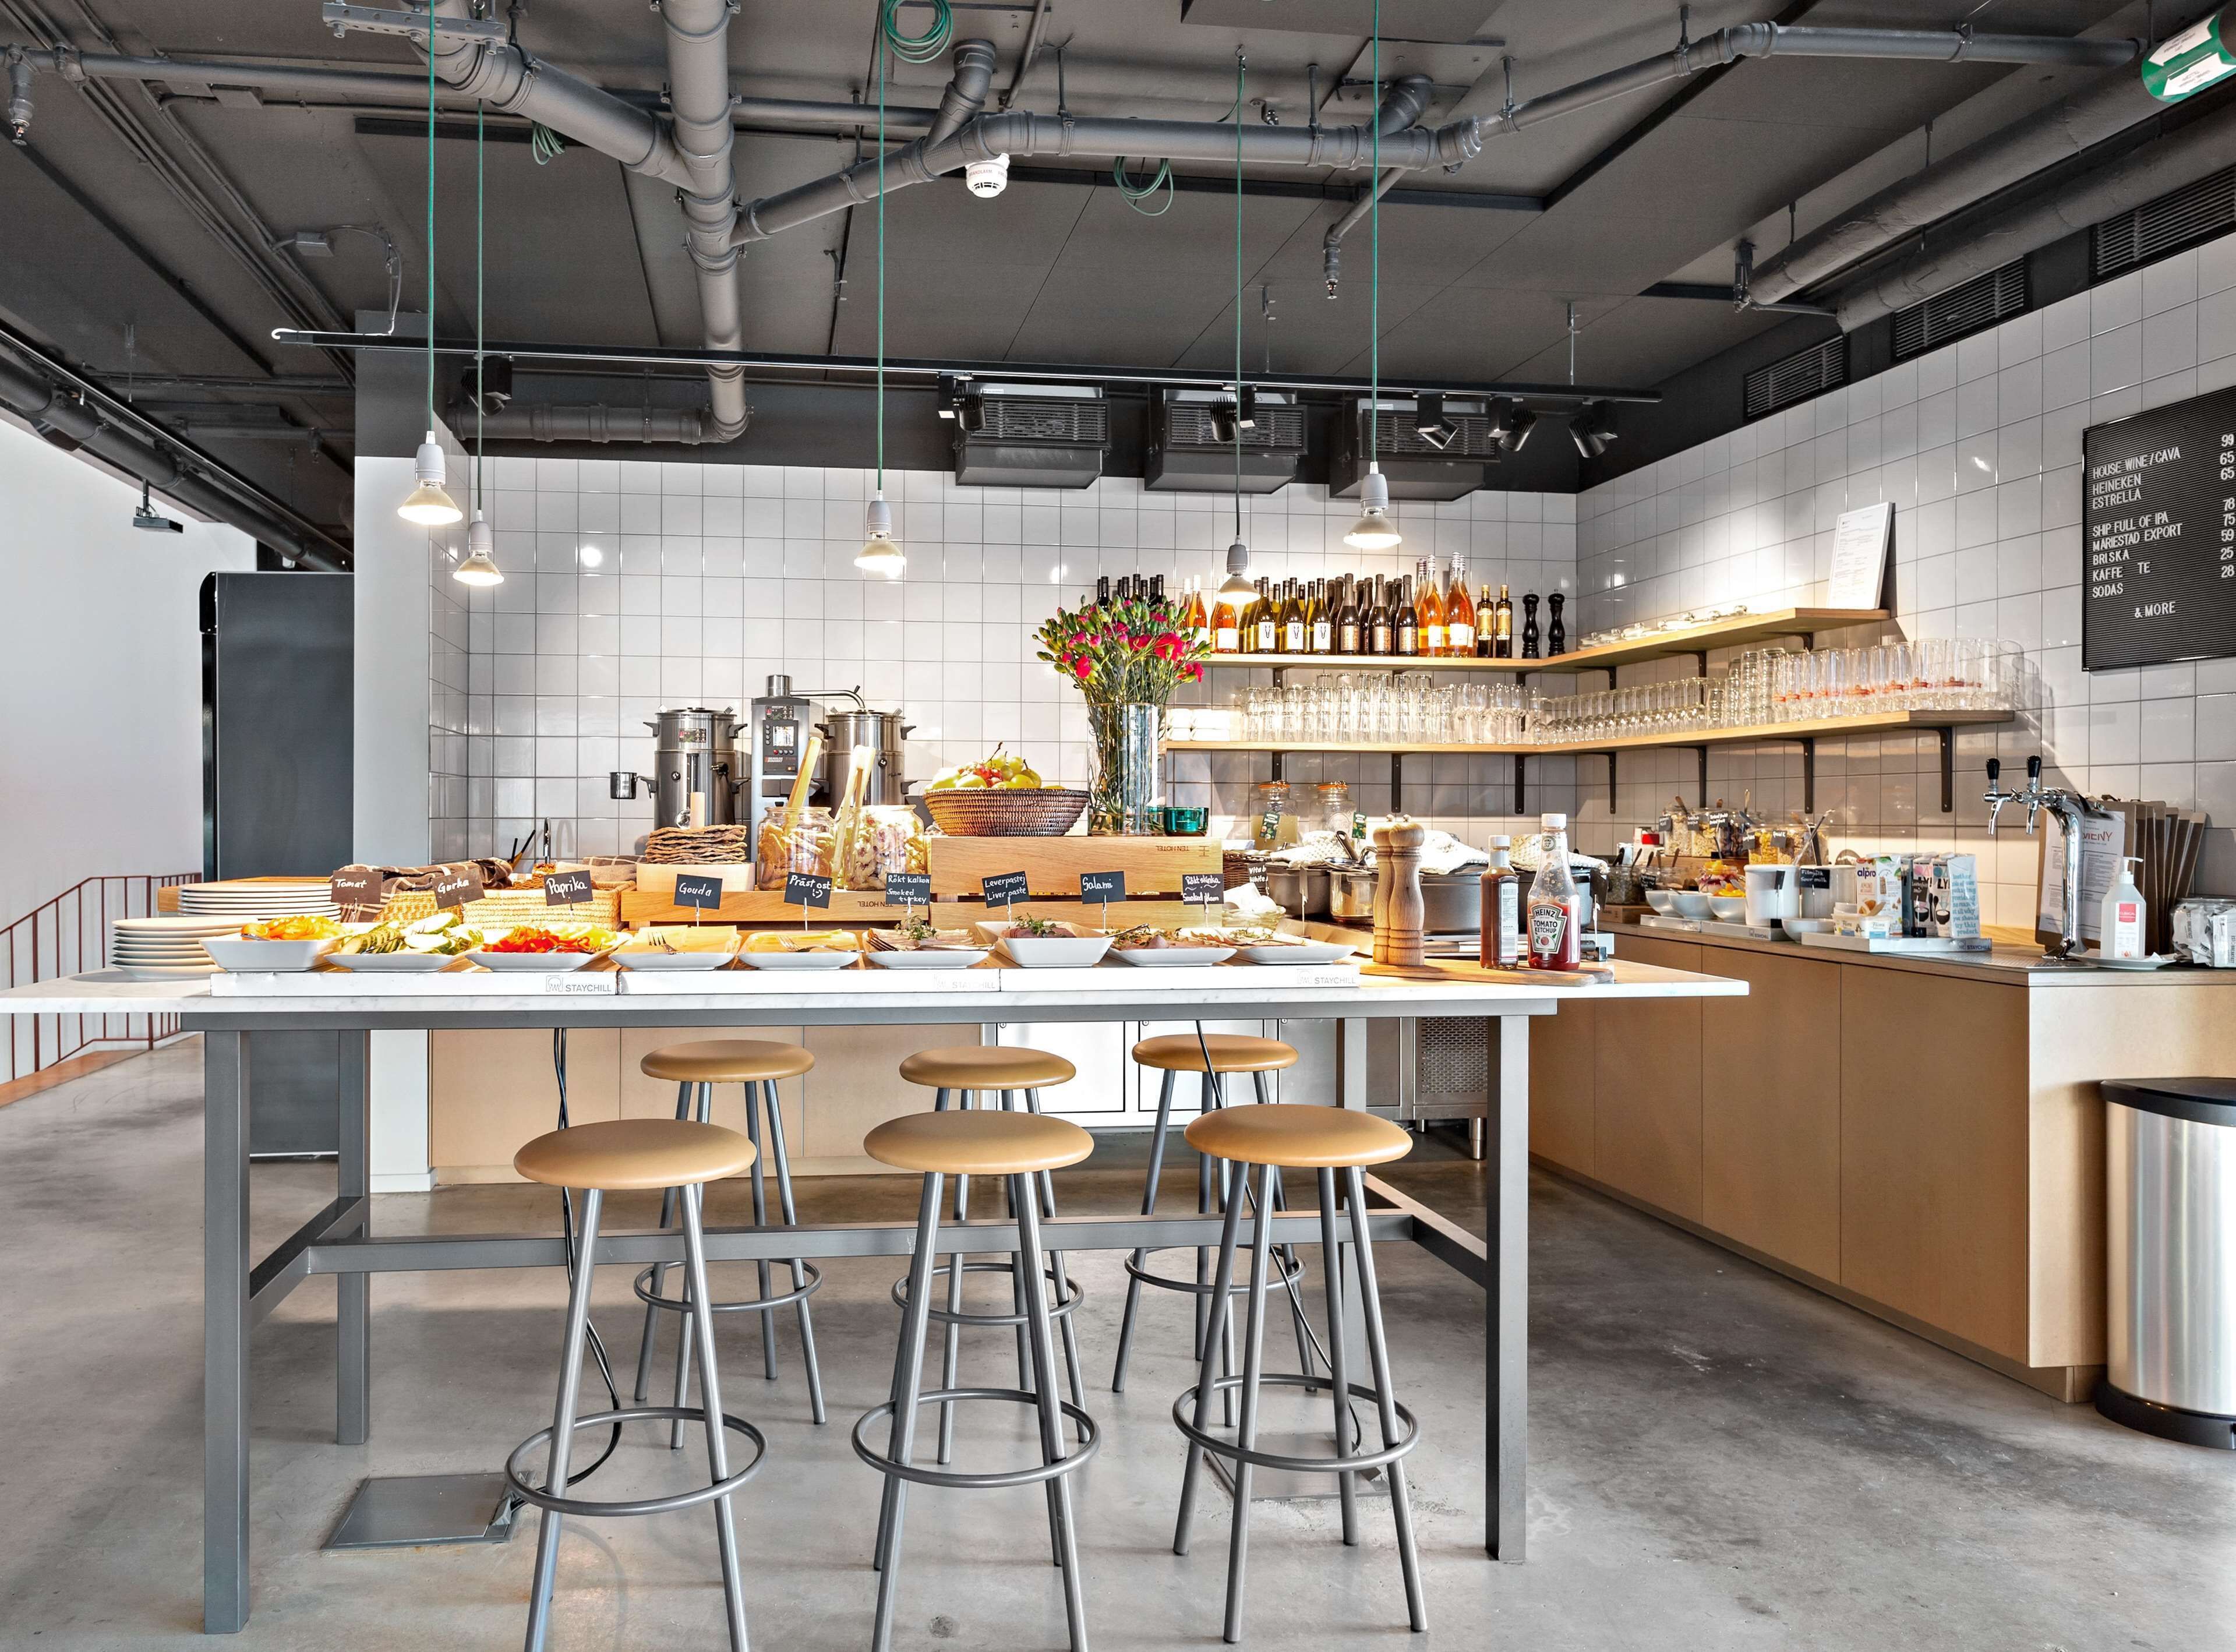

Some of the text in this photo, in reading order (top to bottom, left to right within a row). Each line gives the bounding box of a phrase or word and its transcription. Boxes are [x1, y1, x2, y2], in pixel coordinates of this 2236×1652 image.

[2093, 462, 2121, 479] HOUSE
[2221, 434, 2234, 447] 99
[2093, 451, 2235, 495] HEINEKEN 65
[2093, 467, 2235, 509] ESTRELLA 65
[2093, 497, 2235, 536] SHIP FULL OF IPA 78
[2093, 513, 2235, 552] MARIESTAD EXPORT 75
[2093, 528, 2234, 565] BRISKA 59
[2093, 546, 2234, 582] KAFFE TE 25
[2093, 565, 2235, 598] SODAS 28
[2135, 601, 2175, 618] & MORE
[888, 874, 930, 884] Rökt kalkon
[1200, 874, 1221, 884] skinka
[1857, 867, 1876, 879] alpro
[335, 878, 367, 888] Tomat
[437, 878, 469, 894] Gurka
[546, 876, 587, 898] Paprika
[985, 874, 1025, 888] Leverpastej
[1082, 877, 1113, 891] Salami
[679, 882, 712, 897] Gouda
[987, 887, 1027, 901] Liver paste
[1183, 891, 1203, 902] Smoked
[898, 896, 927, 905] turkey
[1535, 909, 1555, 918] HEINZ
[1534, 920, 1557, 928] TOMATO
